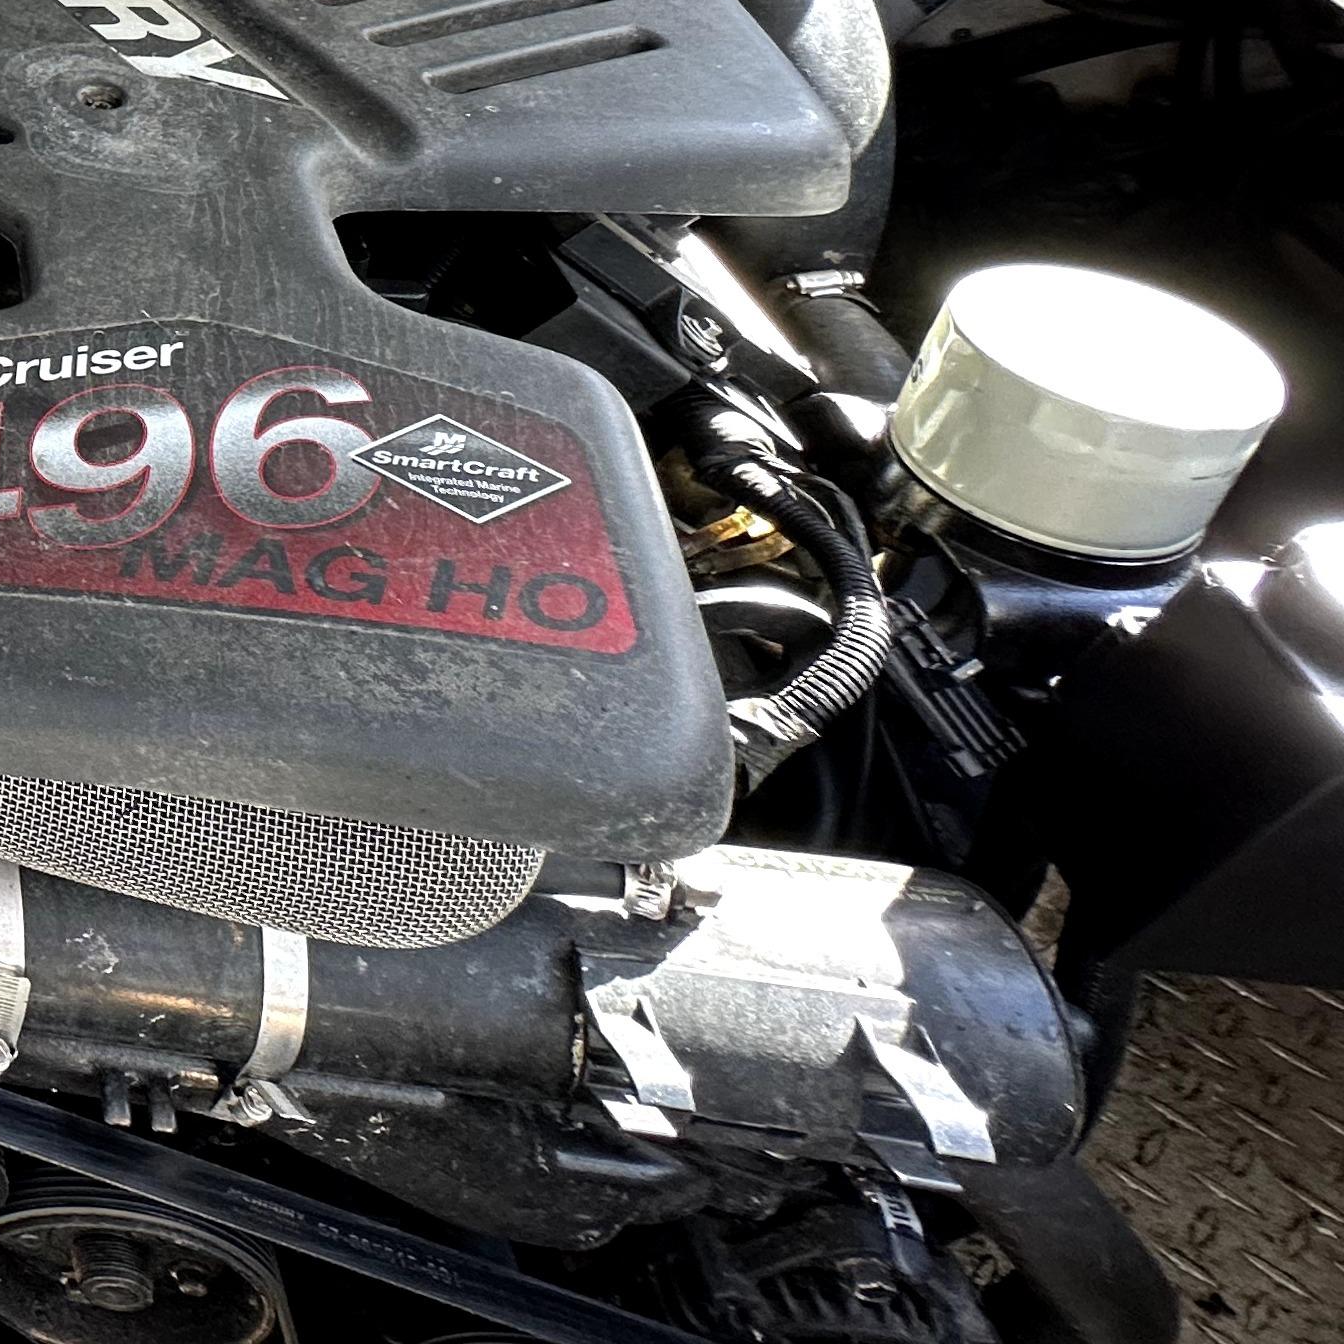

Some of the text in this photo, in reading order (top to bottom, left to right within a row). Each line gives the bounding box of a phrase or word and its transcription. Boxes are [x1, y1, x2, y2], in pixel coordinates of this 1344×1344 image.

[371, 450, 541, 483] SmartCraft
[408, 472, 522, 495] Integrated Marine
[431, 484, 505, 504] Technology
[118, 532, 609, 632] MAG HO
